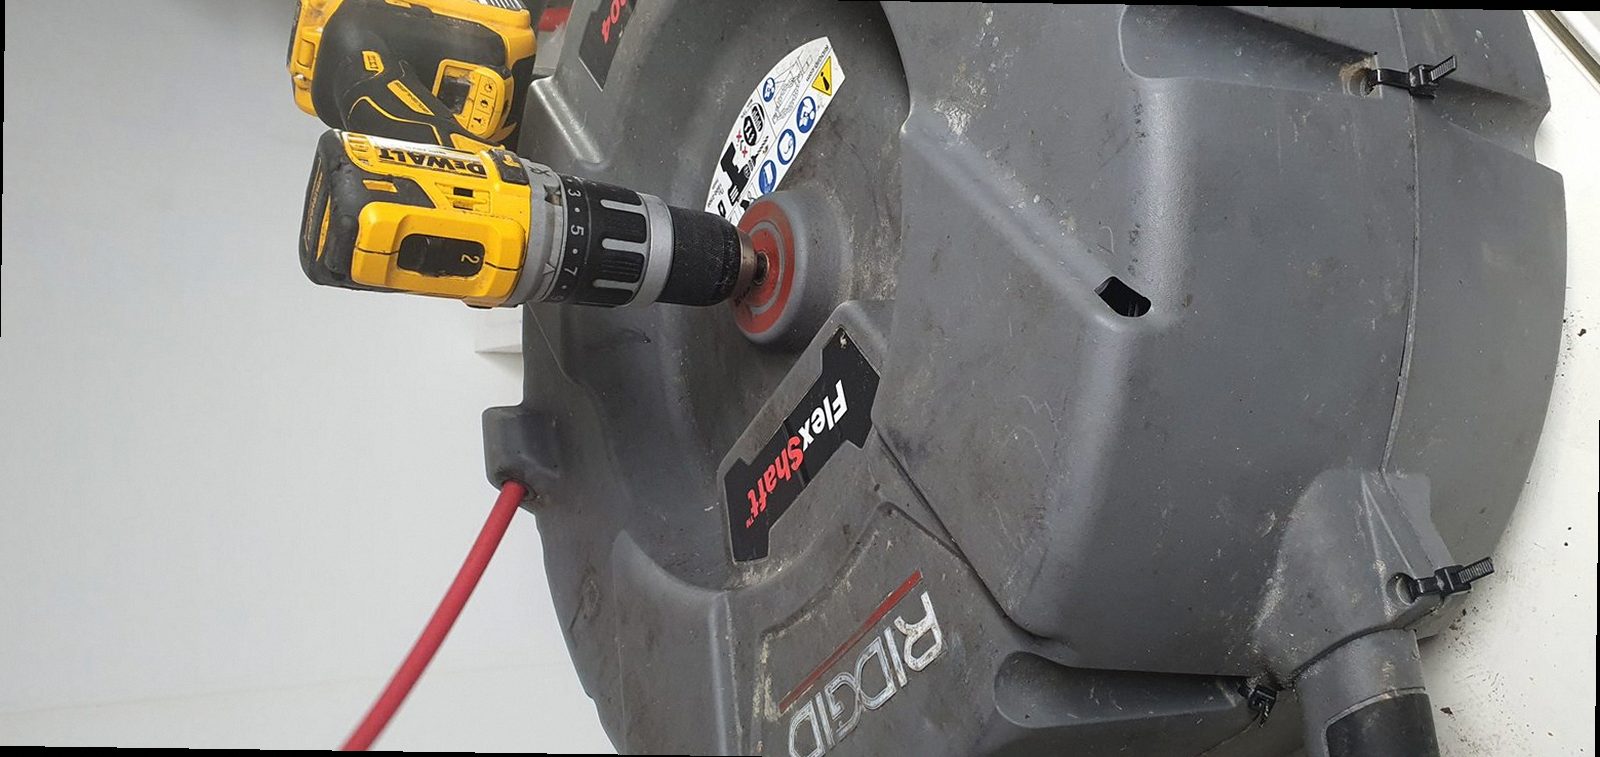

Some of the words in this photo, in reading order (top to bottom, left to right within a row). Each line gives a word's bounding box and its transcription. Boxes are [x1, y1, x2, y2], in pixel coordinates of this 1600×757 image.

[602, 0, 627, 44] 04
[377, 149, 487, 177] DEWALT
[568, 188, 582, 198] 3
[570, 224, 585, 237] 5
[461, 254, 480, 265] 2
[564, 266, 578, 276] 7
[788, 591, 942, 756] RIDGID
